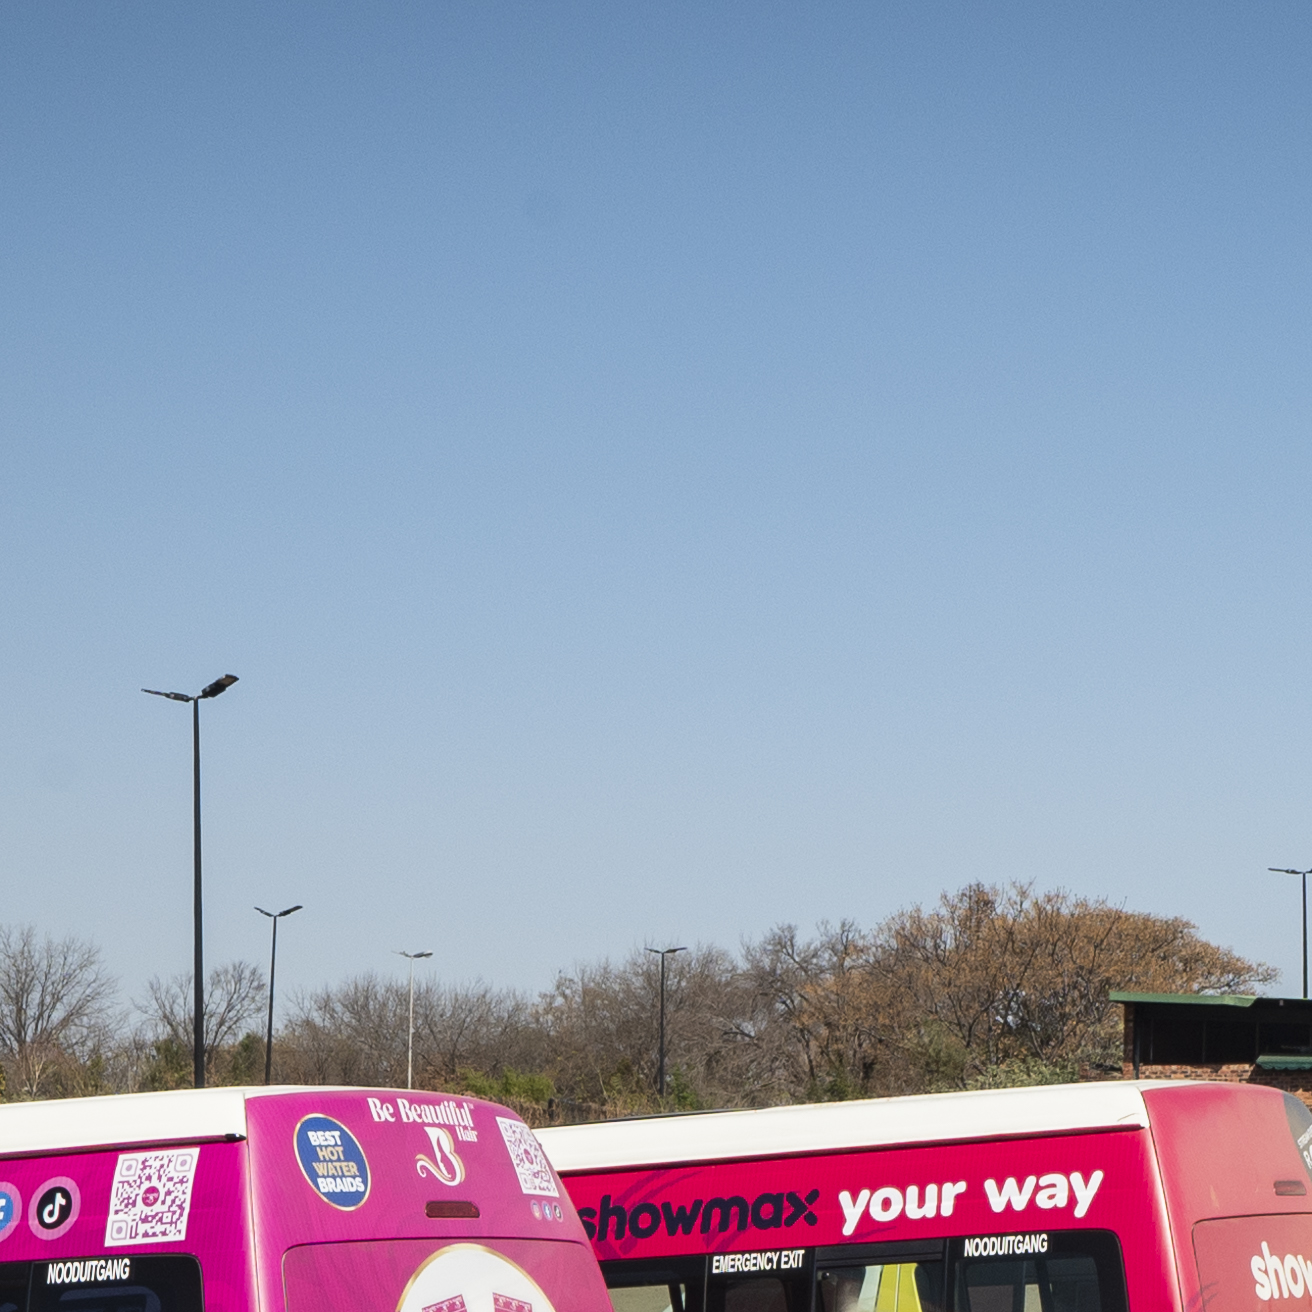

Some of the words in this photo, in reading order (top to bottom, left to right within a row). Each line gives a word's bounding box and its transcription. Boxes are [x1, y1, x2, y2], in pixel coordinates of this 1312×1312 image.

[367, 1097, 396, 1122] Be
[307, 1130, 341, 1147] BEST
[455, 1126, 478, 1142] Hair
[317, 1146, 344, 1161] HOT
[313, 1161, 359, 1177] WATER
[318, 1177, 365, 1194] BRAIDS
[577, 1187, 820, 1242] showmax
[838, 1179, 967, 1236] your
[984, 1169, 1104, 1219] way
[964, 1233, 1048, 1257] NOODUITGANG
[47, 1257, 130, 1285] NOODUITGANG
[712, 1252, 779, 1274] EMERGENCY
[781, 1249, 806, 1270] EXIT
